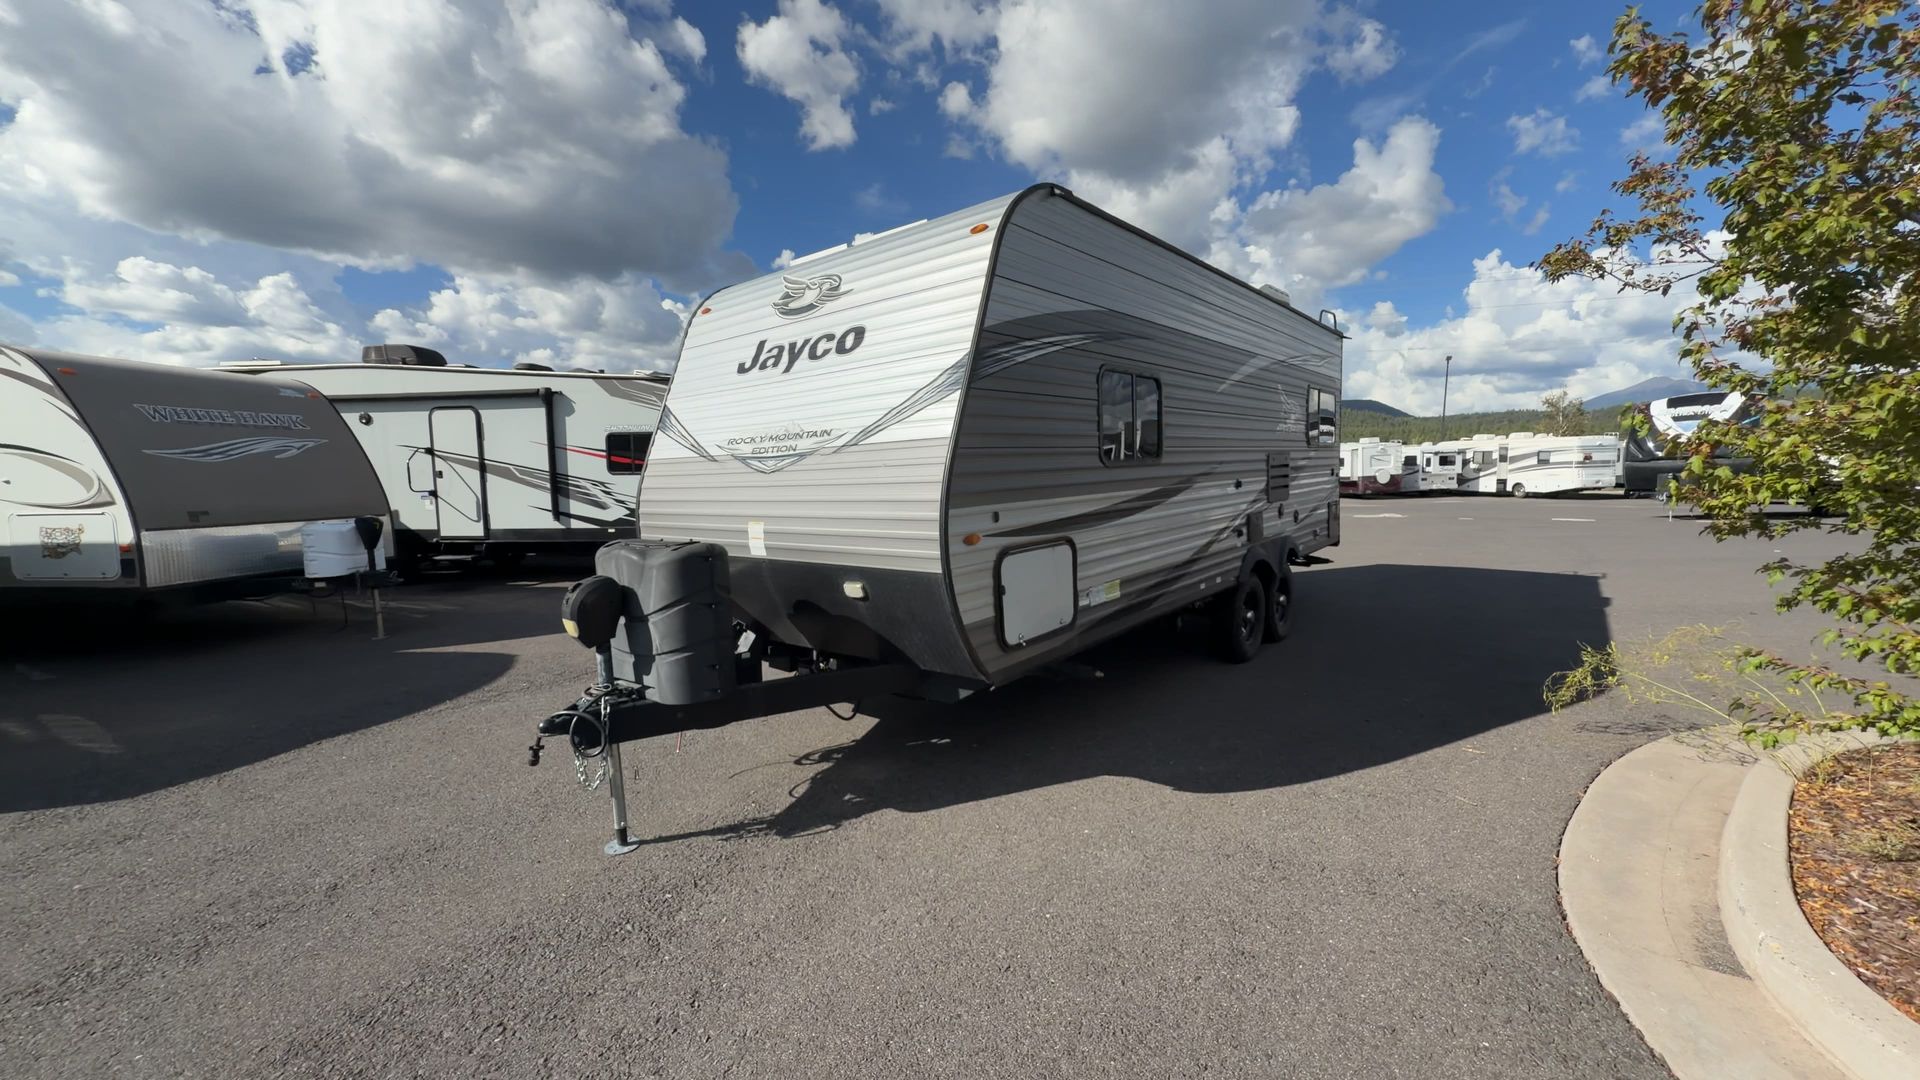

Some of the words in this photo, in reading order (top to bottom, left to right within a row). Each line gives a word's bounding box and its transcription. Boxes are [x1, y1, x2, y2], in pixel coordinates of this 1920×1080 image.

[737, 325, 866, 374] Jayco
[132, 403, 235, 424] WHITE
[235, 410, 311, 430] HAWK
[727, 435, 767, 446] ROCKY
[768, 428, 833, 443] MOUNTAIN
[751, 443, 798, 455] EDITION
